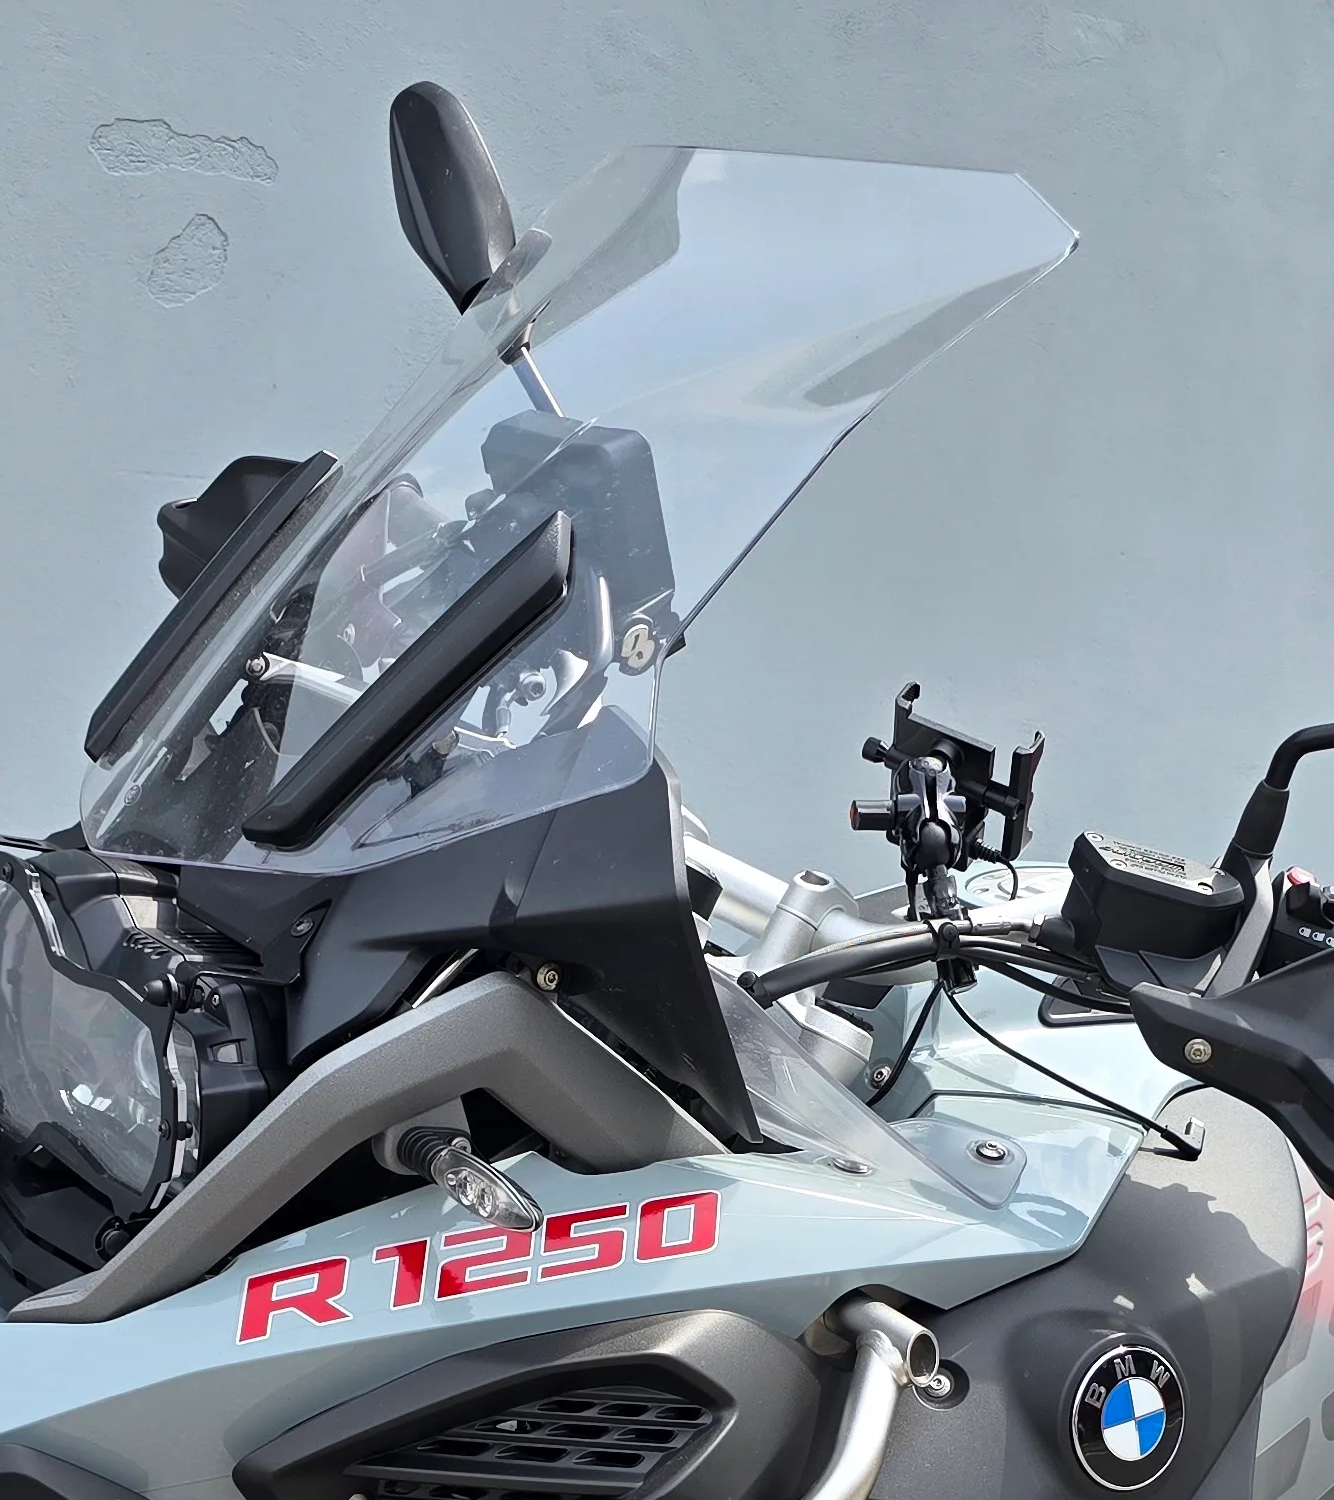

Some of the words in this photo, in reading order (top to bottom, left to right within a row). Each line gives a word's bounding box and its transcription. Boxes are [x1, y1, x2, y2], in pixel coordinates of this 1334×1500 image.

[235, 1255, 351, 1346] R
[372, 1189, 722, 1311] 1250
[1085, 1355, 1171, 1409] BMW
